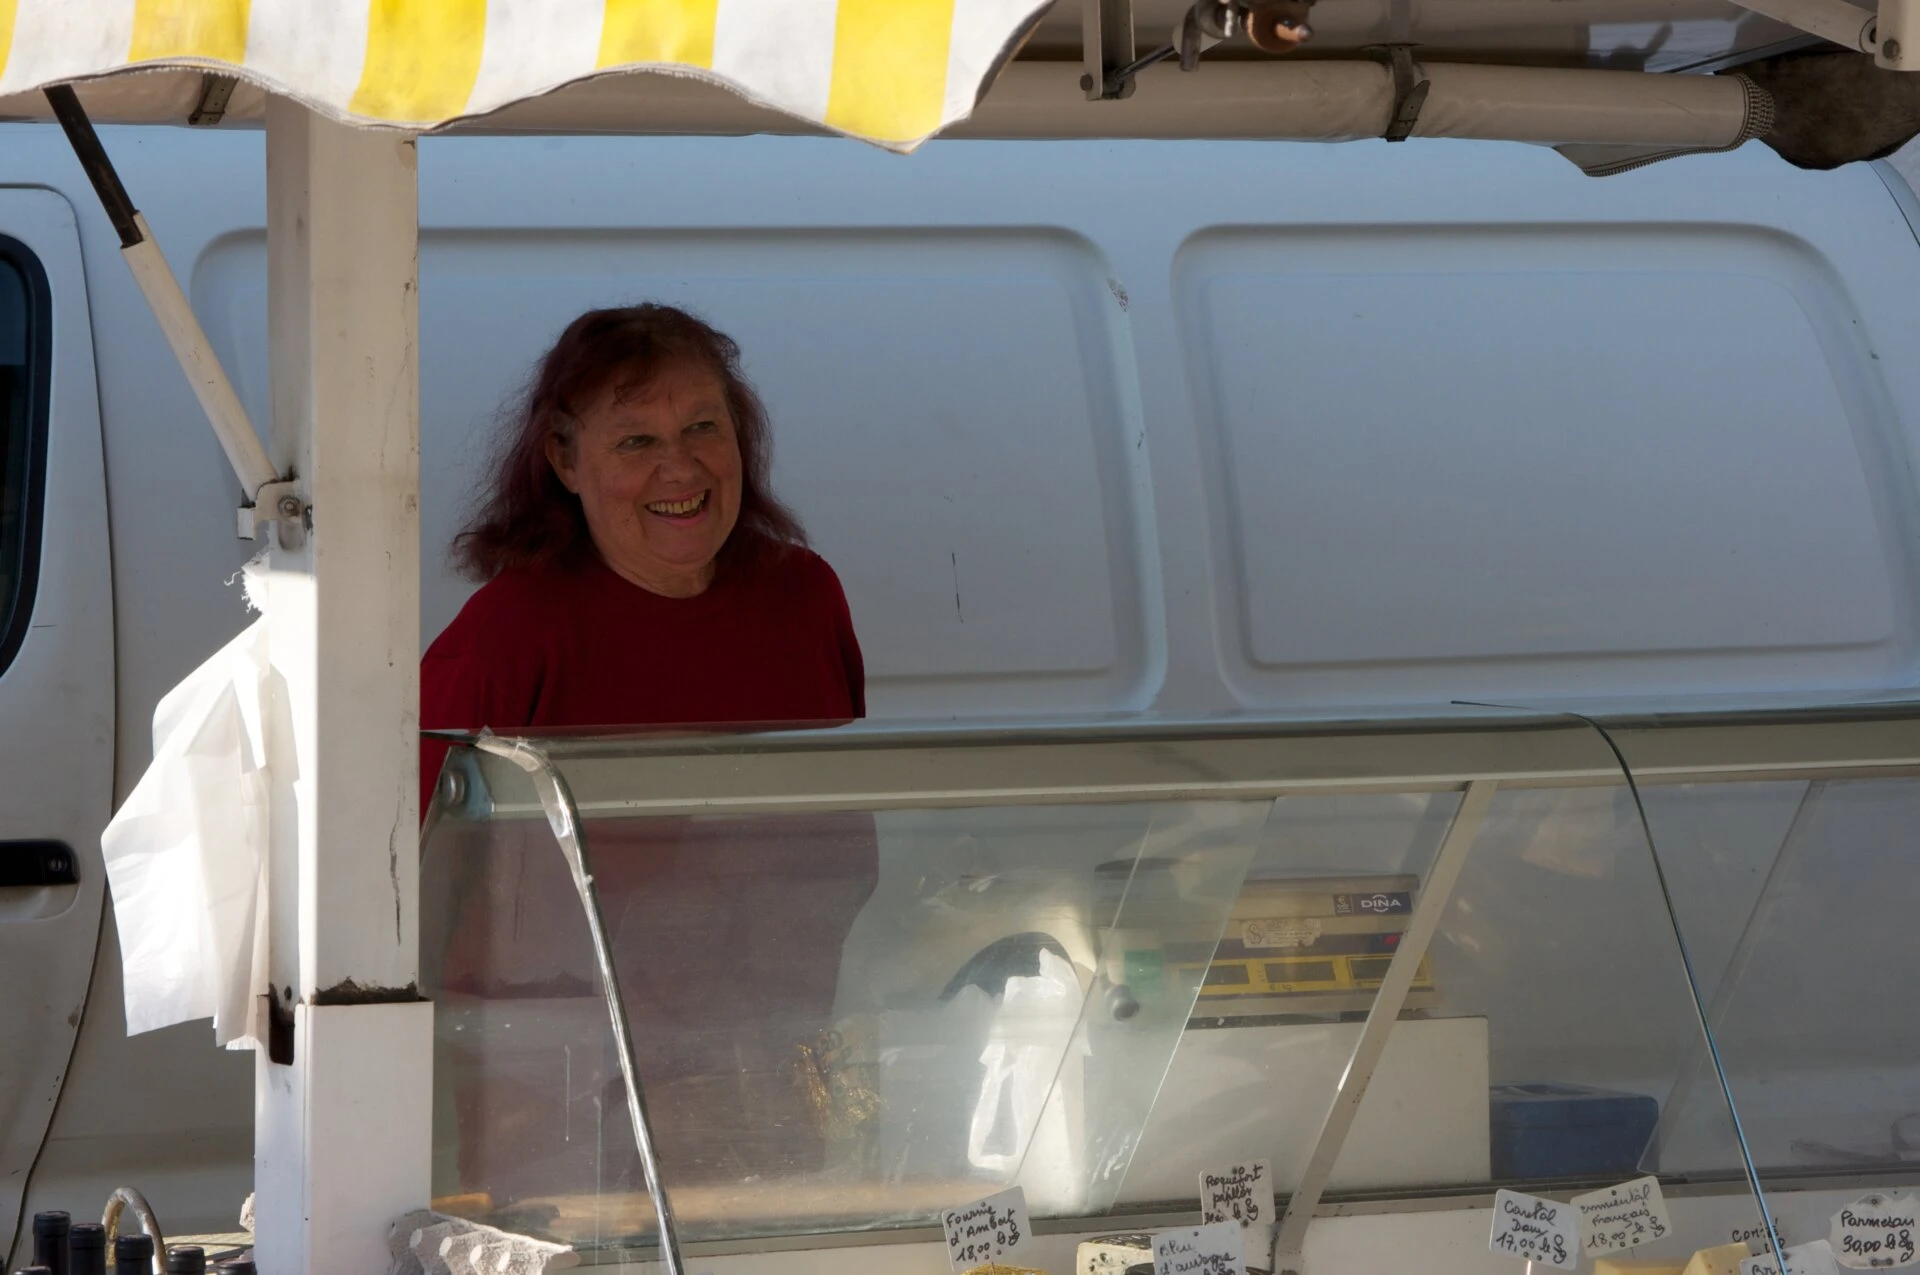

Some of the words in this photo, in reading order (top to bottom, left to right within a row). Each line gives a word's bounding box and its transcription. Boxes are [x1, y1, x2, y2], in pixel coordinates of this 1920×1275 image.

[1361, 899, 1402, 908] DINA
[1841, 1210, 1915, 1229] Parmesan
[1495, 1232, 1535, 1253] 17,00
